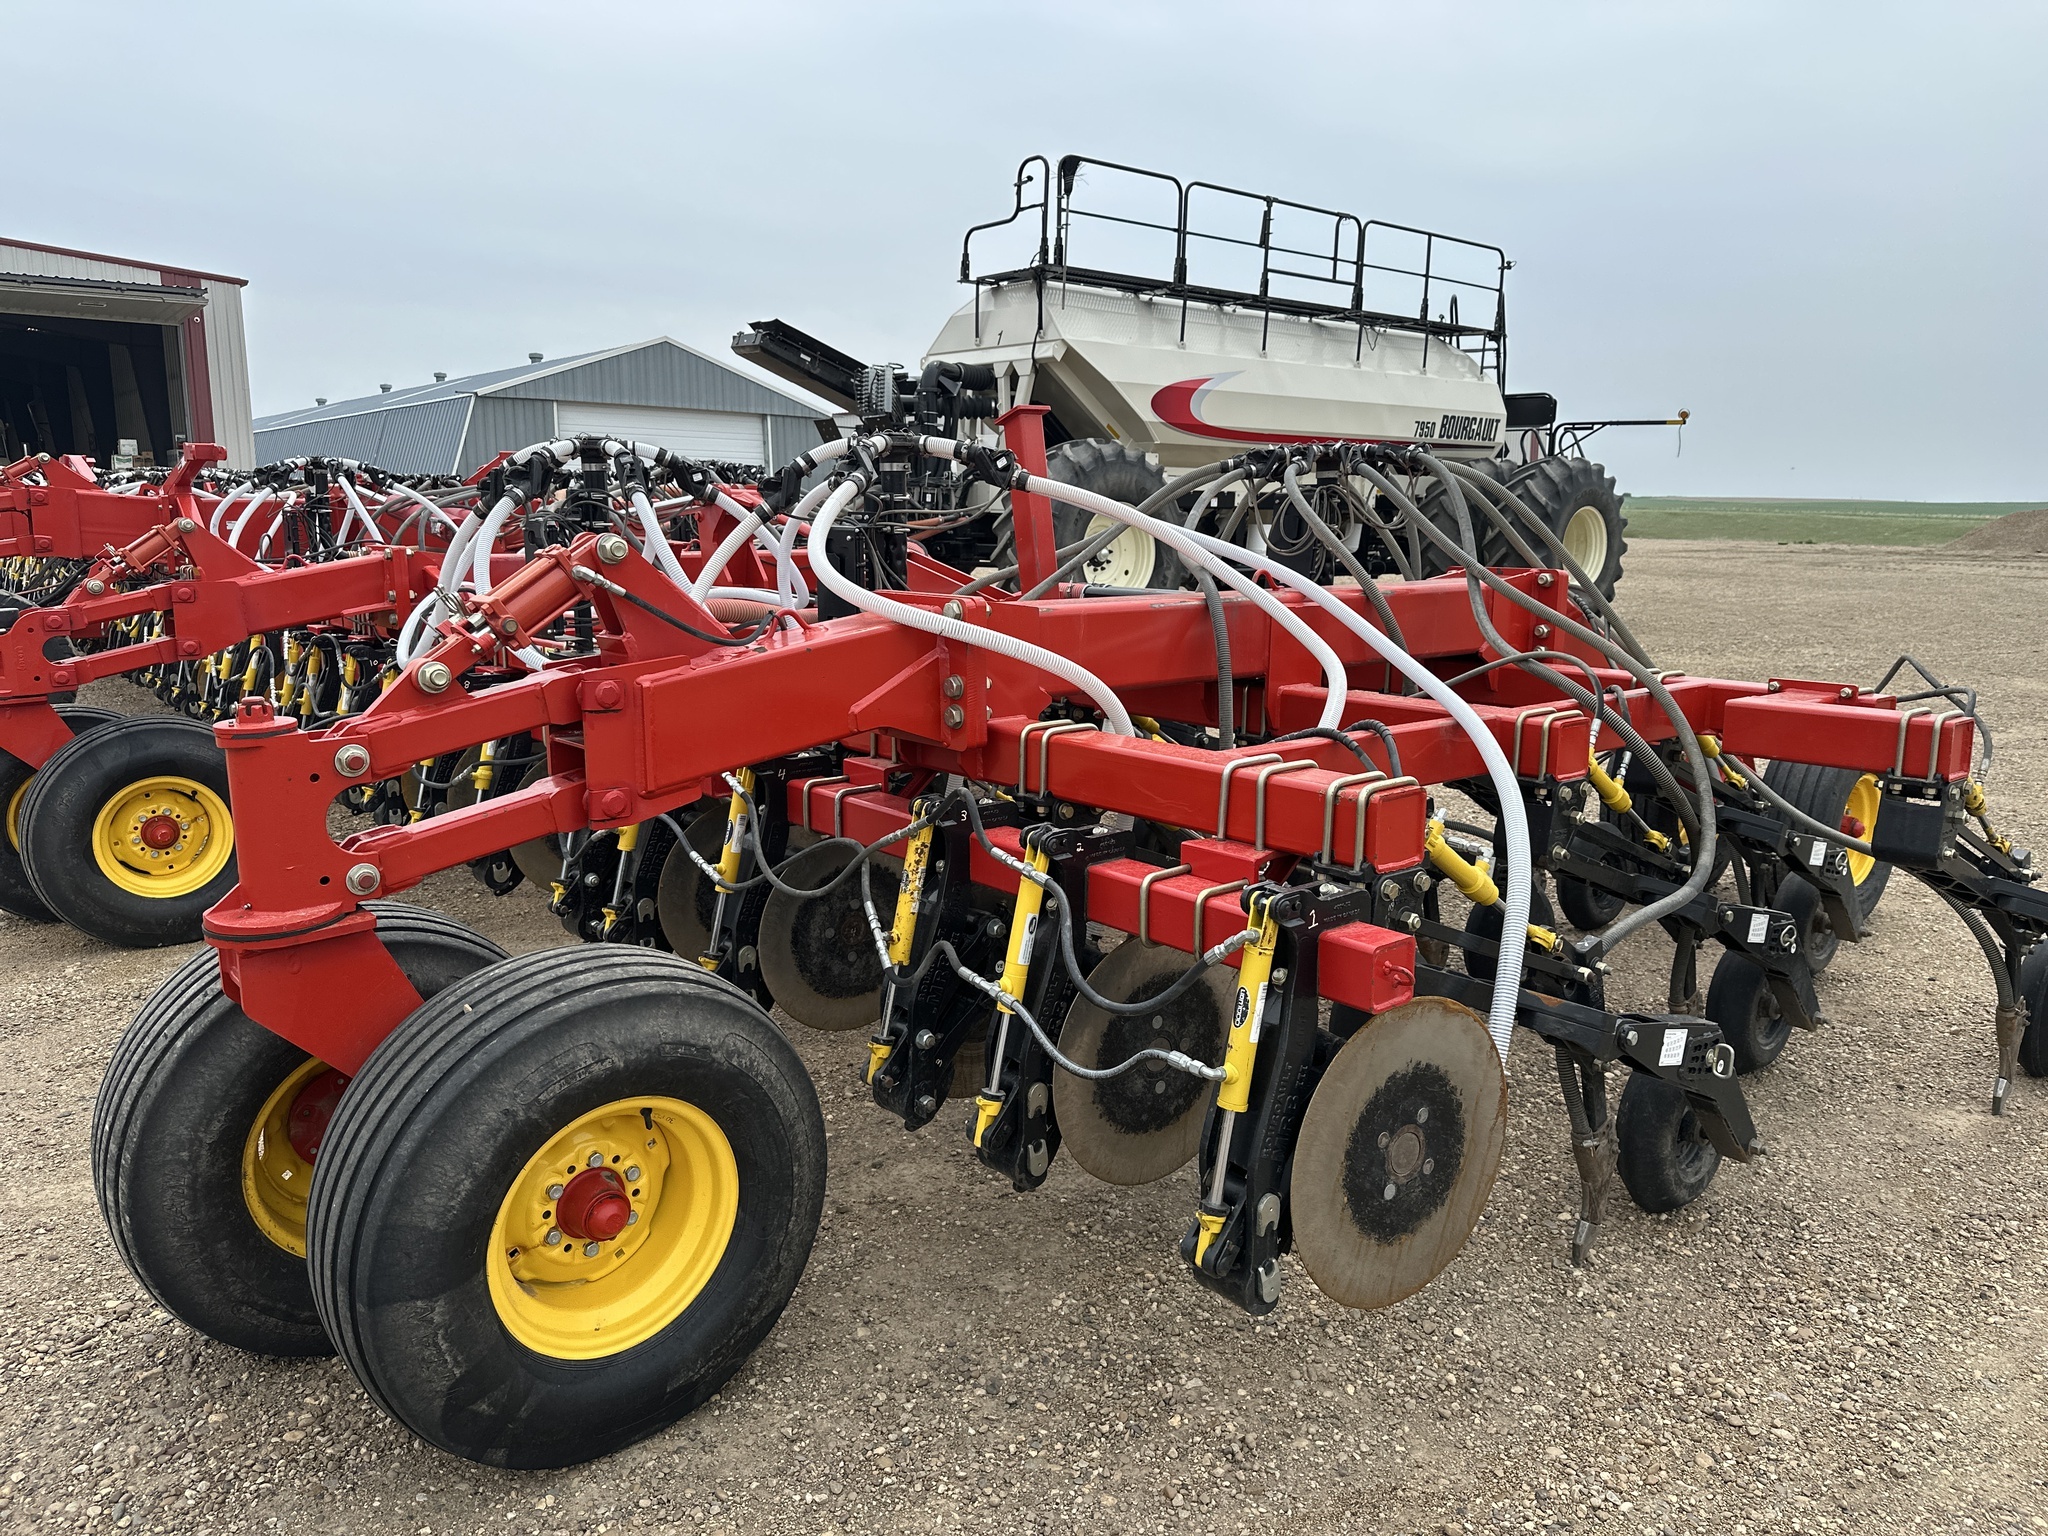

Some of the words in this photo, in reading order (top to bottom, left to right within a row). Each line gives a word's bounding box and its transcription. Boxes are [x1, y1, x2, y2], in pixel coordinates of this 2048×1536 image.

[1414, 421, 1436, 438] 7950
[1438, 414, 1501, 442] BOURGAULT
[778, 769, 785, 780] 4
[961, 810, 967, 821] 3
[1076, 842, 1084, 852] 2
[1308, 909, 1319, 929] 1
[1261, 1061, 1293, 1159] BOURGAULT
[1271, 1095, 1299, 1161] MRB
